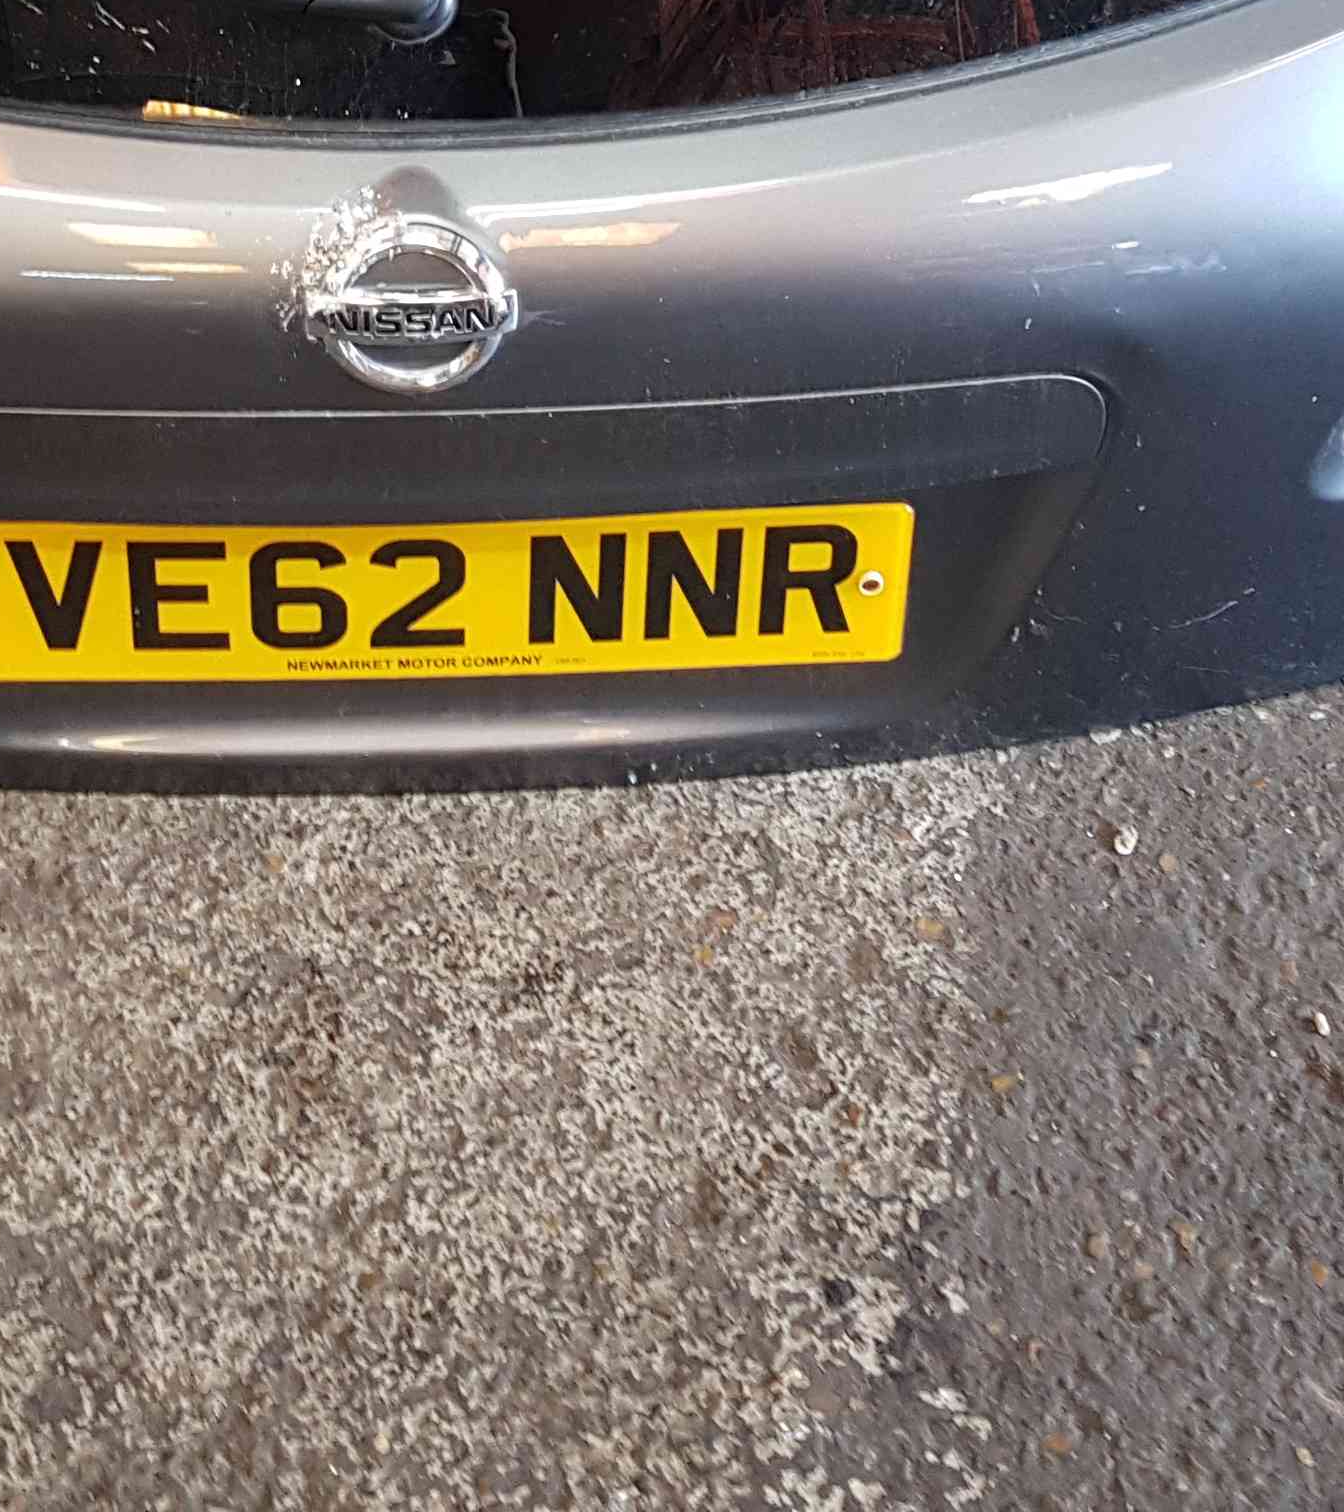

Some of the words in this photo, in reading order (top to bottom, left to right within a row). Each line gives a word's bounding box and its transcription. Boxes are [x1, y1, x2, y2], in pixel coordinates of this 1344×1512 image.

[328, 303, 496, 336] NISSAN
[3, 538, 468, 652] VE62
[526, 523, 859, 645] NNR
[286, 659, 392, 673] NEWMARKET
[397, 657, 457, 670] MOTOR
[461, 654, 543, 669] COMPANY
